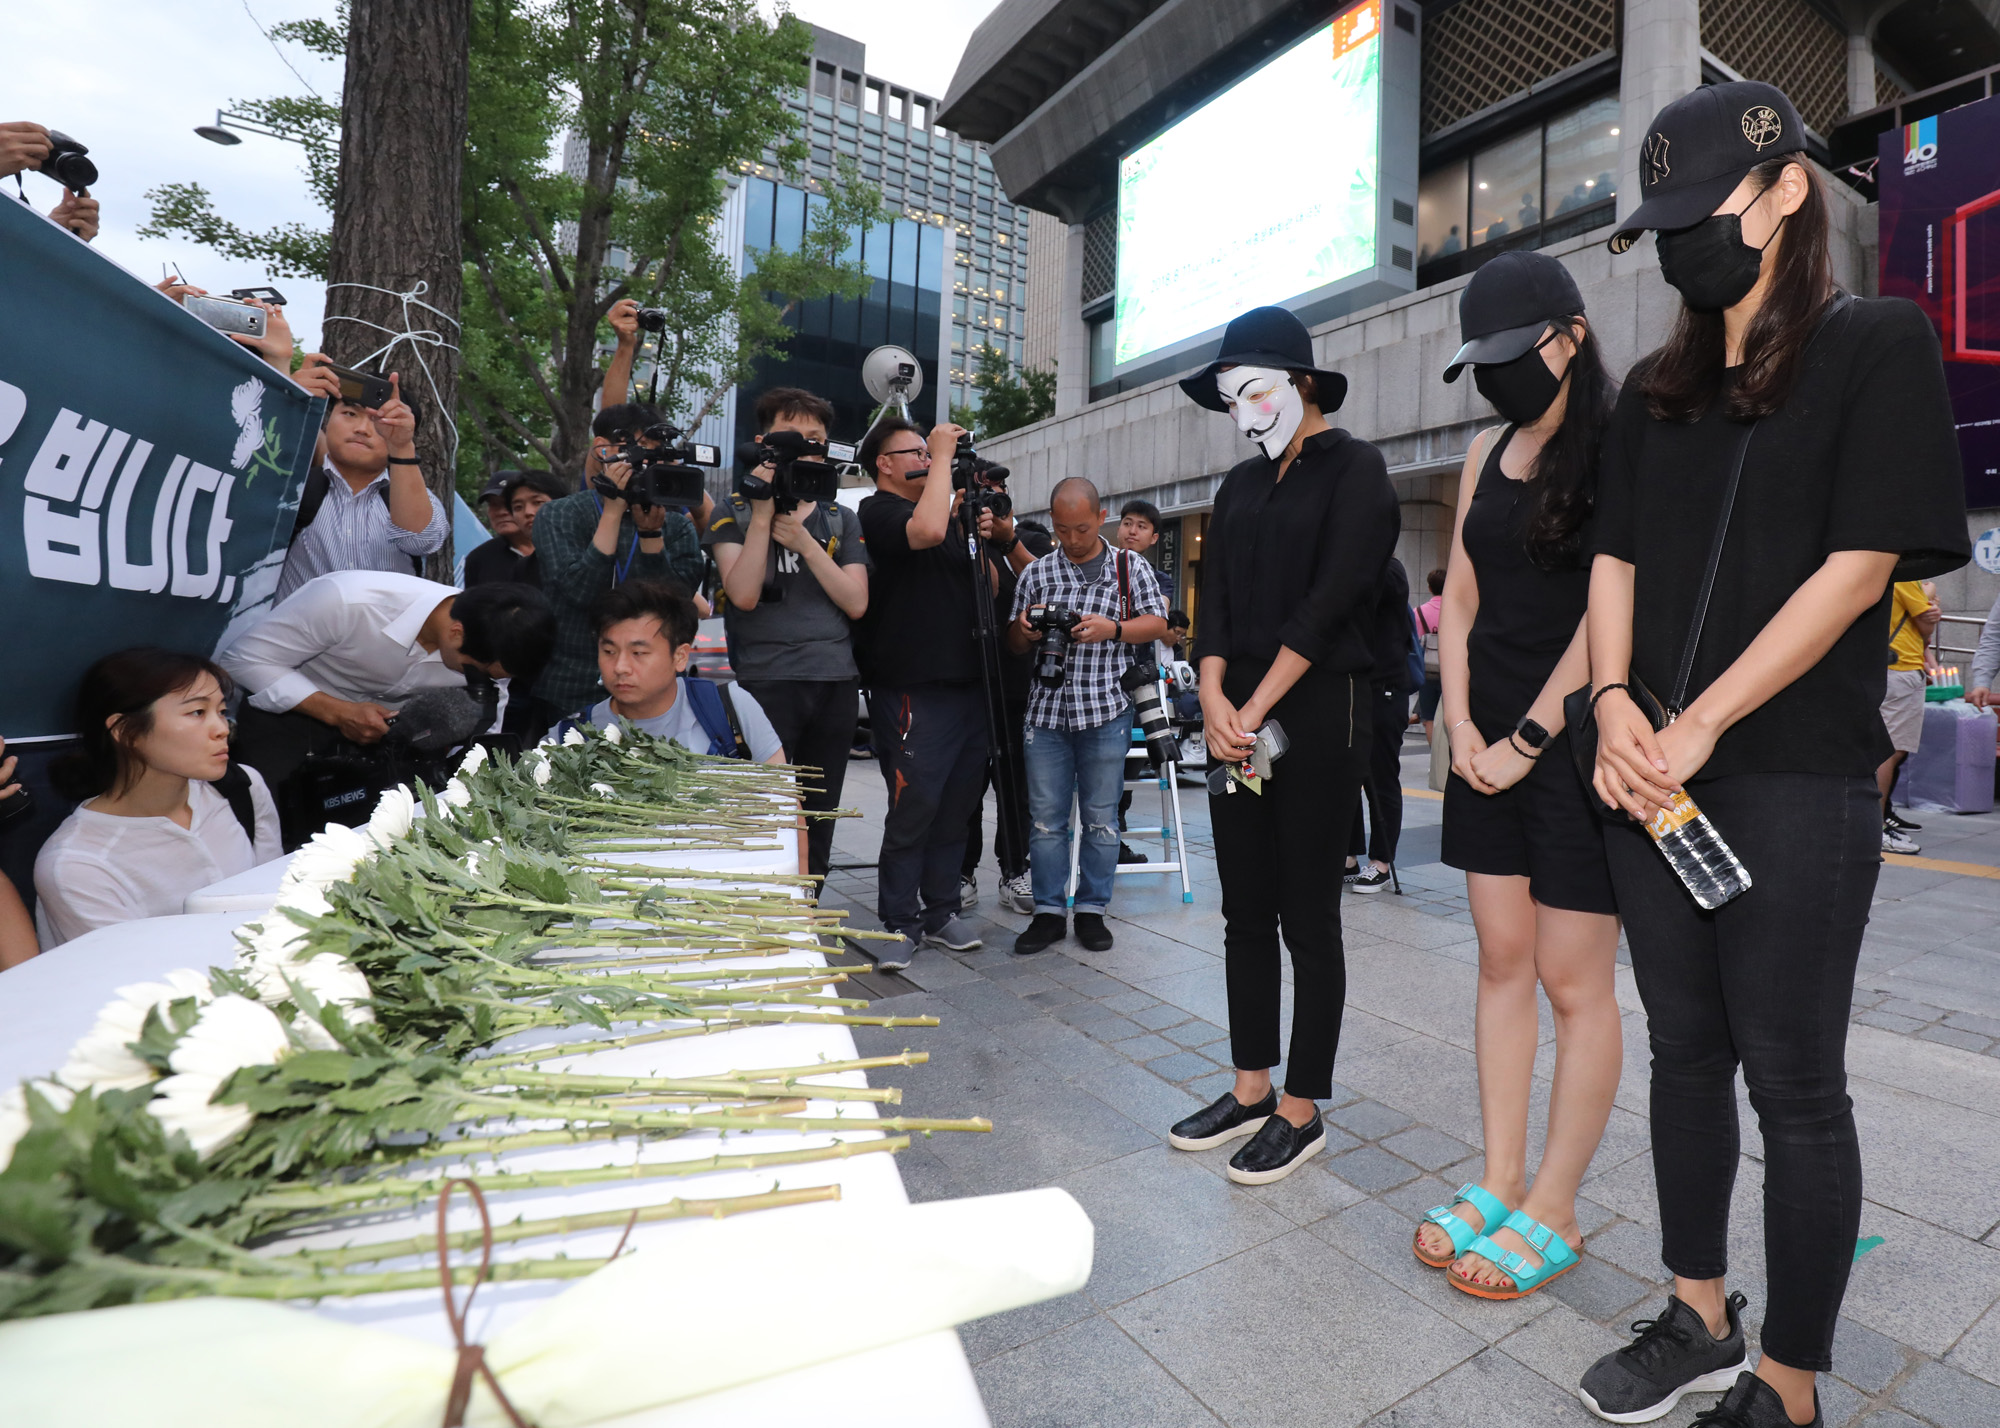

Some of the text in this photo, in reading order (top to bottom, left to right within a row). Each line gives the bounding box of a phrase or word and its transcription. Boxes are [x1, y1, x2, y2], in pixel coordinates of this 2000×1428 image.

[1904, 143, 1938, 164] 40
[324, 788, 366, 809] KBS NEWS
